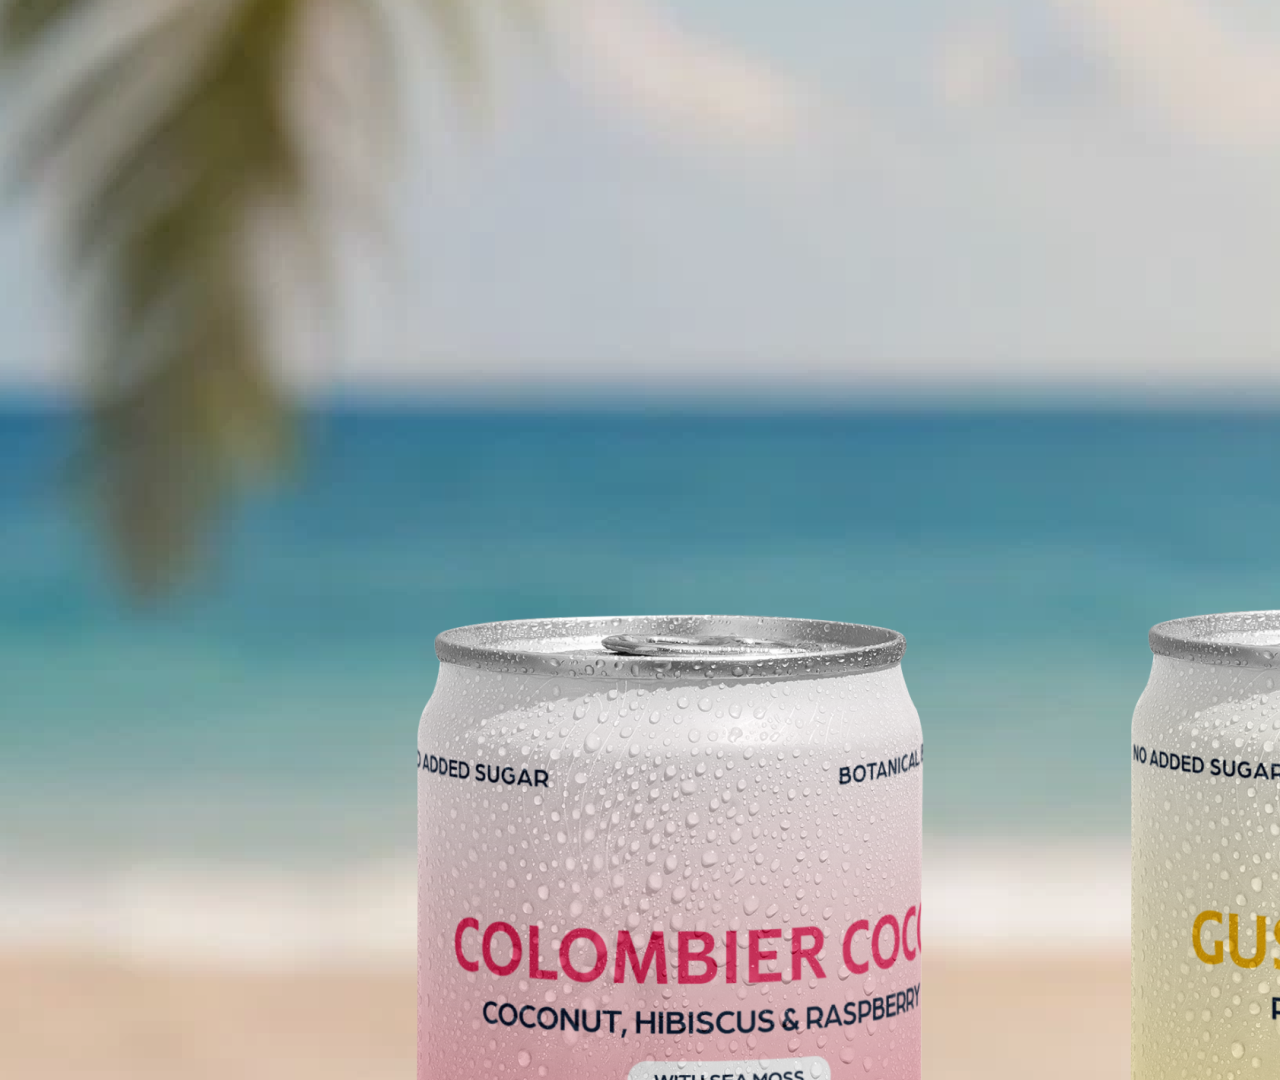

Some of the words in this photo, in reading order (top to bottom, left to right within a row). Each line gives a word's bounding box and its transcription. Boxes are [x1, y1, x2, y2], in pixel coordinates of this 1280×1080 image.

[423, 753, 470, 779] ADDED
[475, 764, 549, 788] SUGAR
[839, 750, 920, 785] BOTANICAL
[1133, 744, 1147, 764] NO
[1150, 749, 1205, 773] ADDED
[455, 917, 827, 985] COLOMBIER
[842, 902, 922, 975] COC
[482, 1001, 628, 1038] COCONUT,
[636, 1010, 775, 1036] HIBISCUS
[782, 1007, 800, 1031] &
[805, 982, 921, 1030] RASPBERRY
